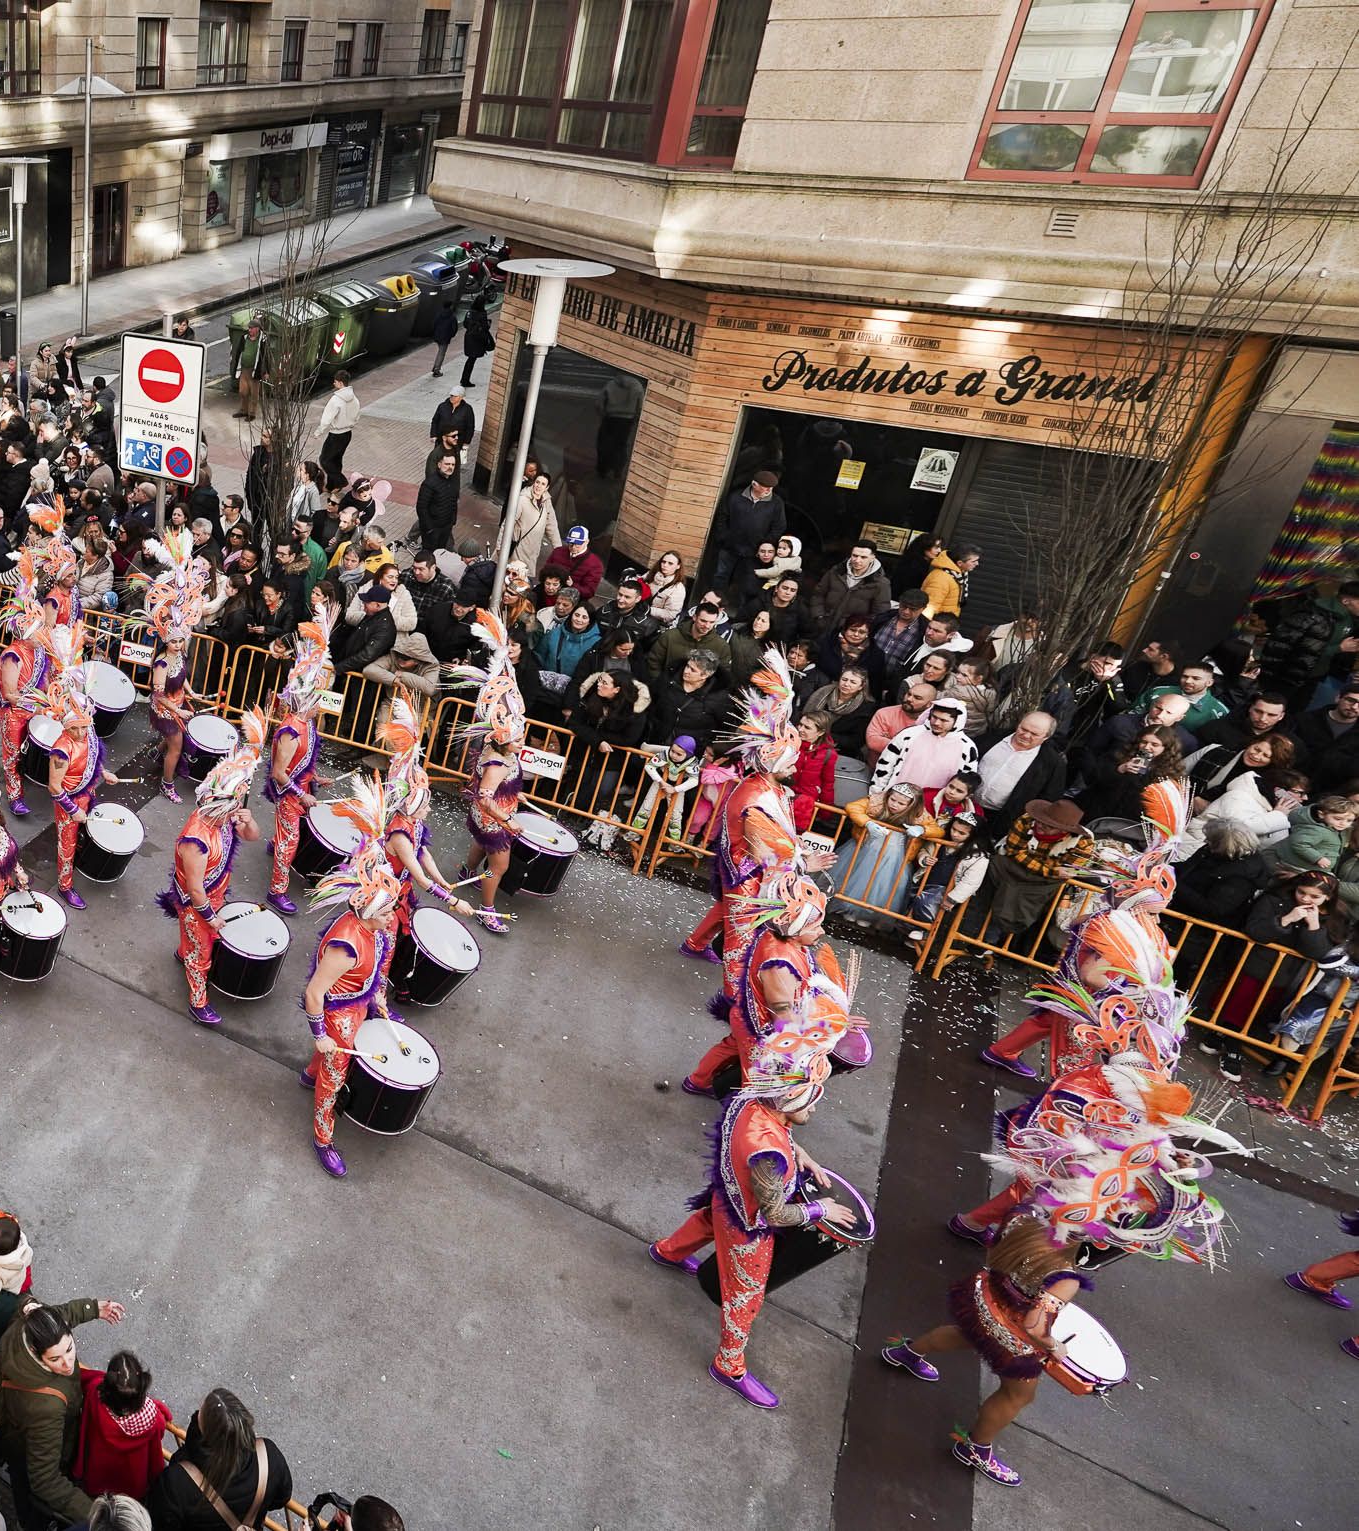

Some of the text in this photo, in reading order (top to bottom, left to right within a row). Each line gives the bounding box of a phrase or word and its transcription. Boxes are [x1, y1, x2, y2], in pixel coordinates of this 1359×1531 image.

[596, 293, 620, 331] DE
[622, 301, 696, 356] AMELIA
[761, 350, 1168, 407] Produtos a Granel
[909, 401, 935, 413] HERBAS
[124, 416, 163, 429] URXENCIAS
[148, 430, 175, 442] GARAXE
